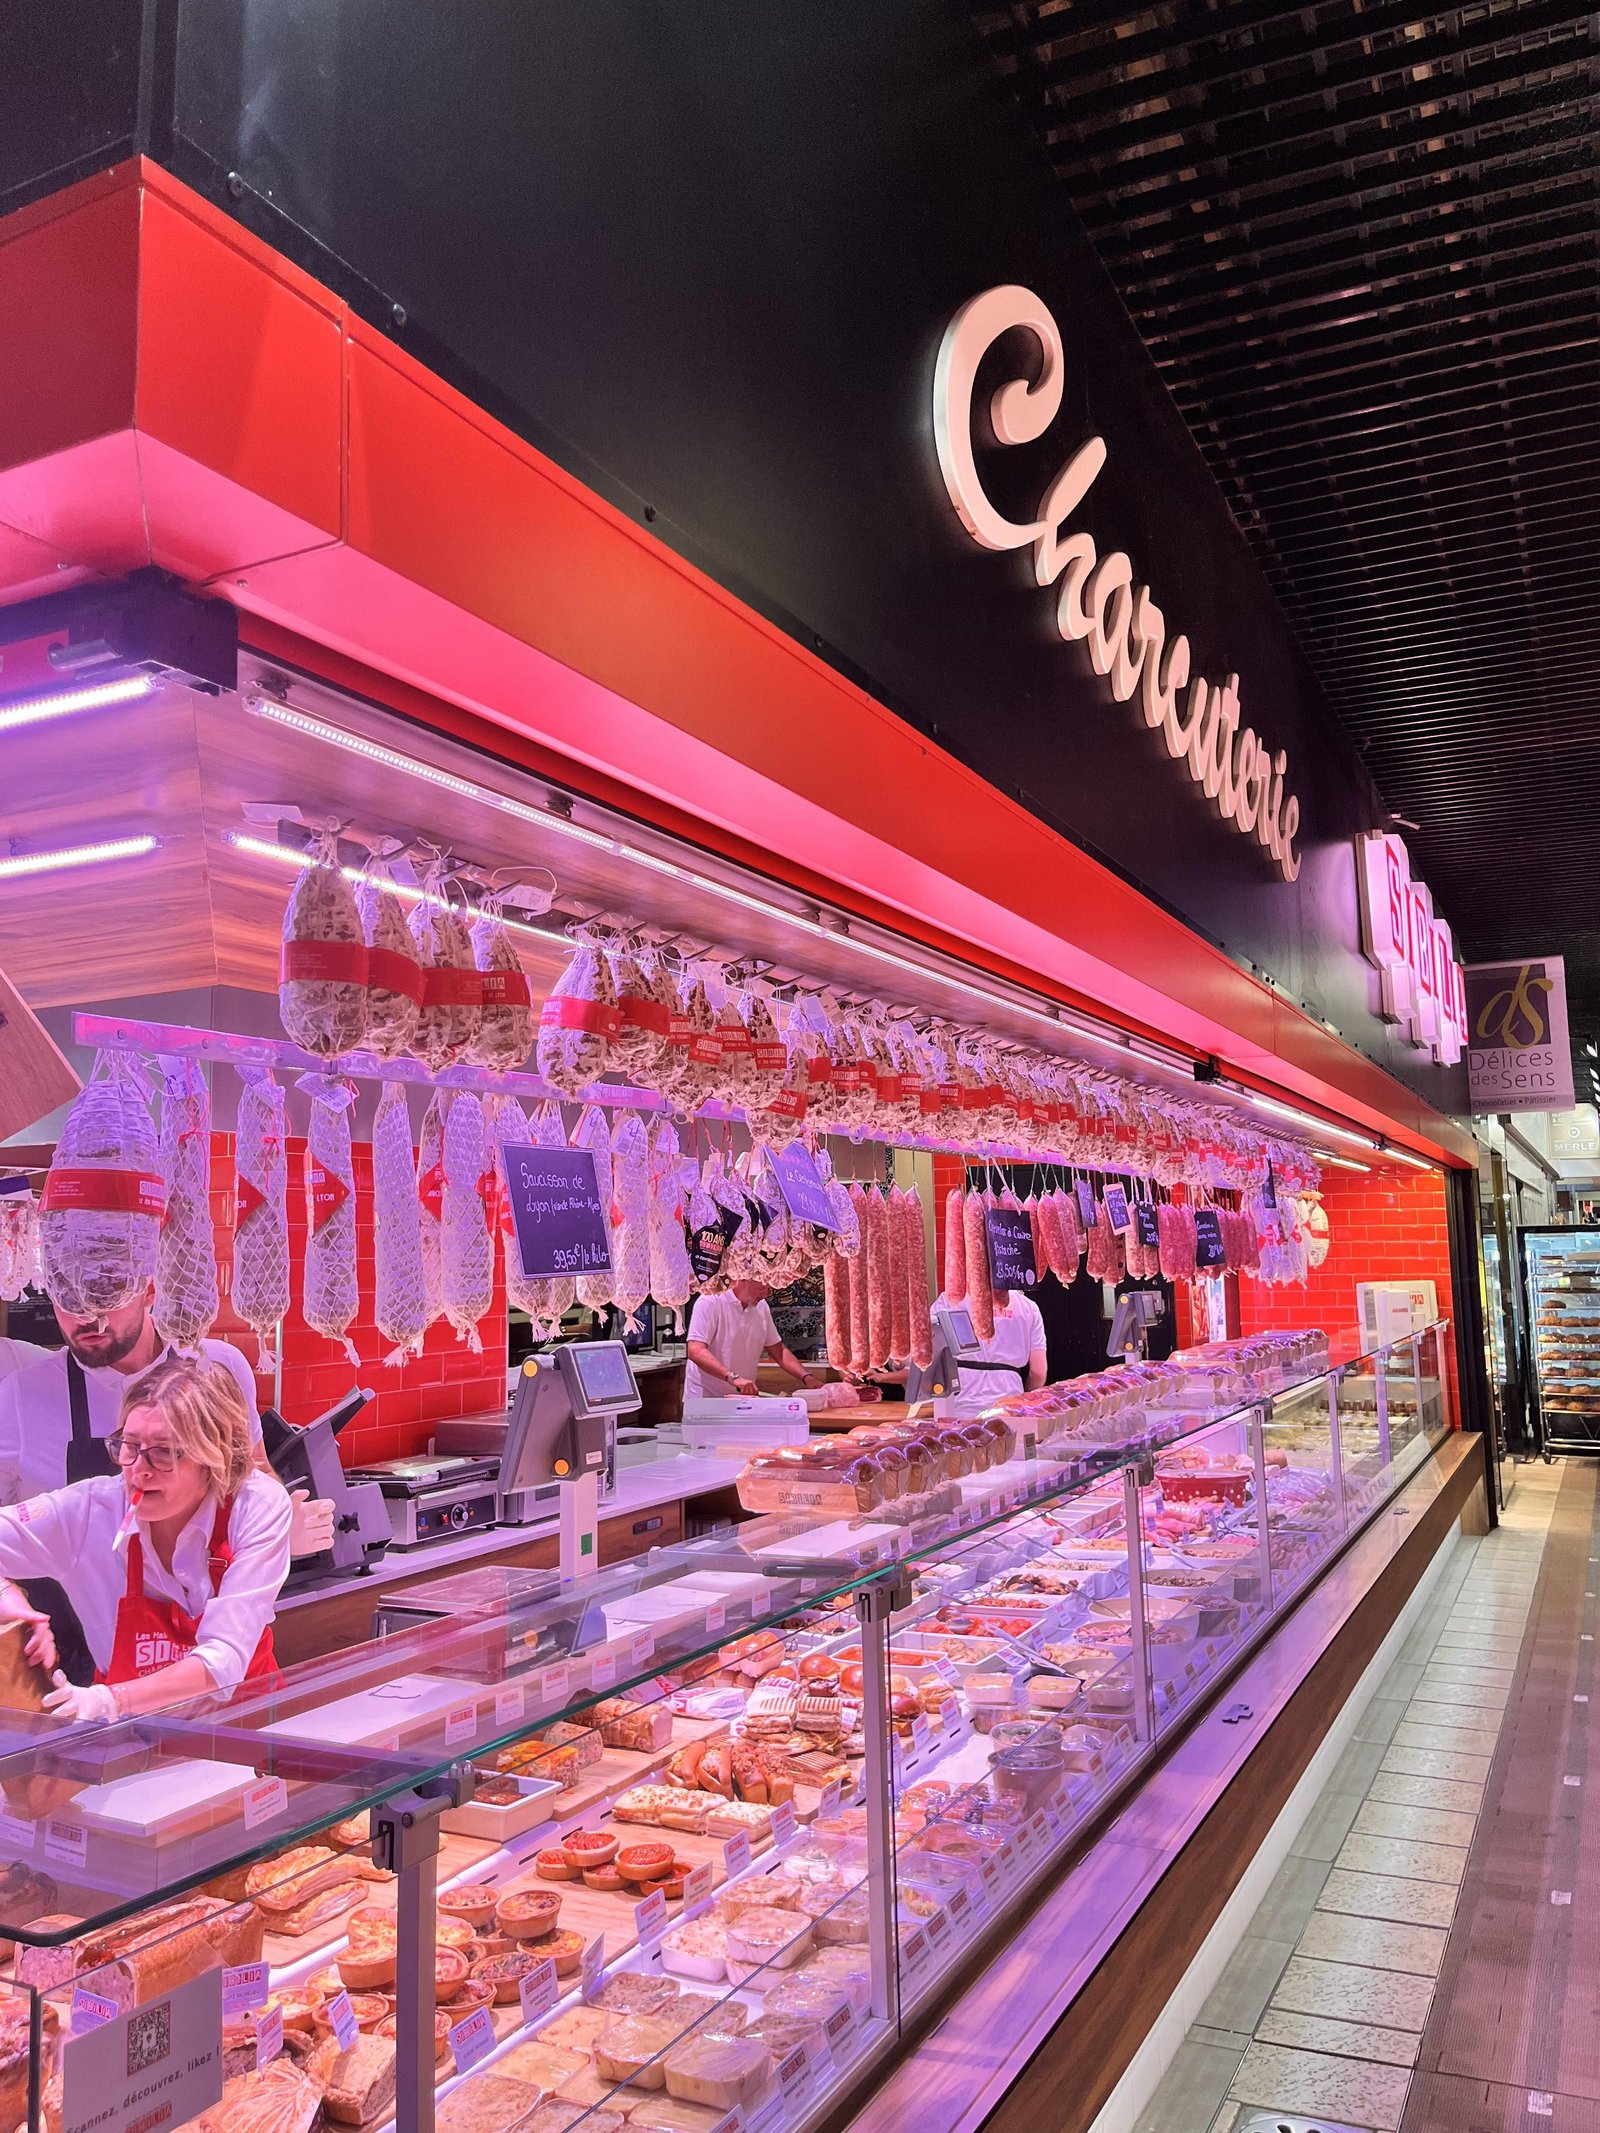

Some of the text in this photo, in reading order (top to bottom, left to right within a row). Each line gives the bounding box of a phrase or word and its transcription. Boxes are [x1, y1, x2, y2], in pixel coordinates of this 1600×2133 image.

[934, 284, 1302, 882] Charcuterie
[1469, 1050, 1554, 1071] Délices
[1471, 1070, 1555, 1089] des Sens
[1472, 1095, 1557, 1108] Chocolatier Pâtissier
[1554, 1142, 1596, 1152] MERLE
[520, 1162, 586, 1190] Saucisson de
[135, 1632, 151, 1641] Les
[122, 2068, 184, 2108] découvrez,
[187, 2051, 212, 2073] likez
